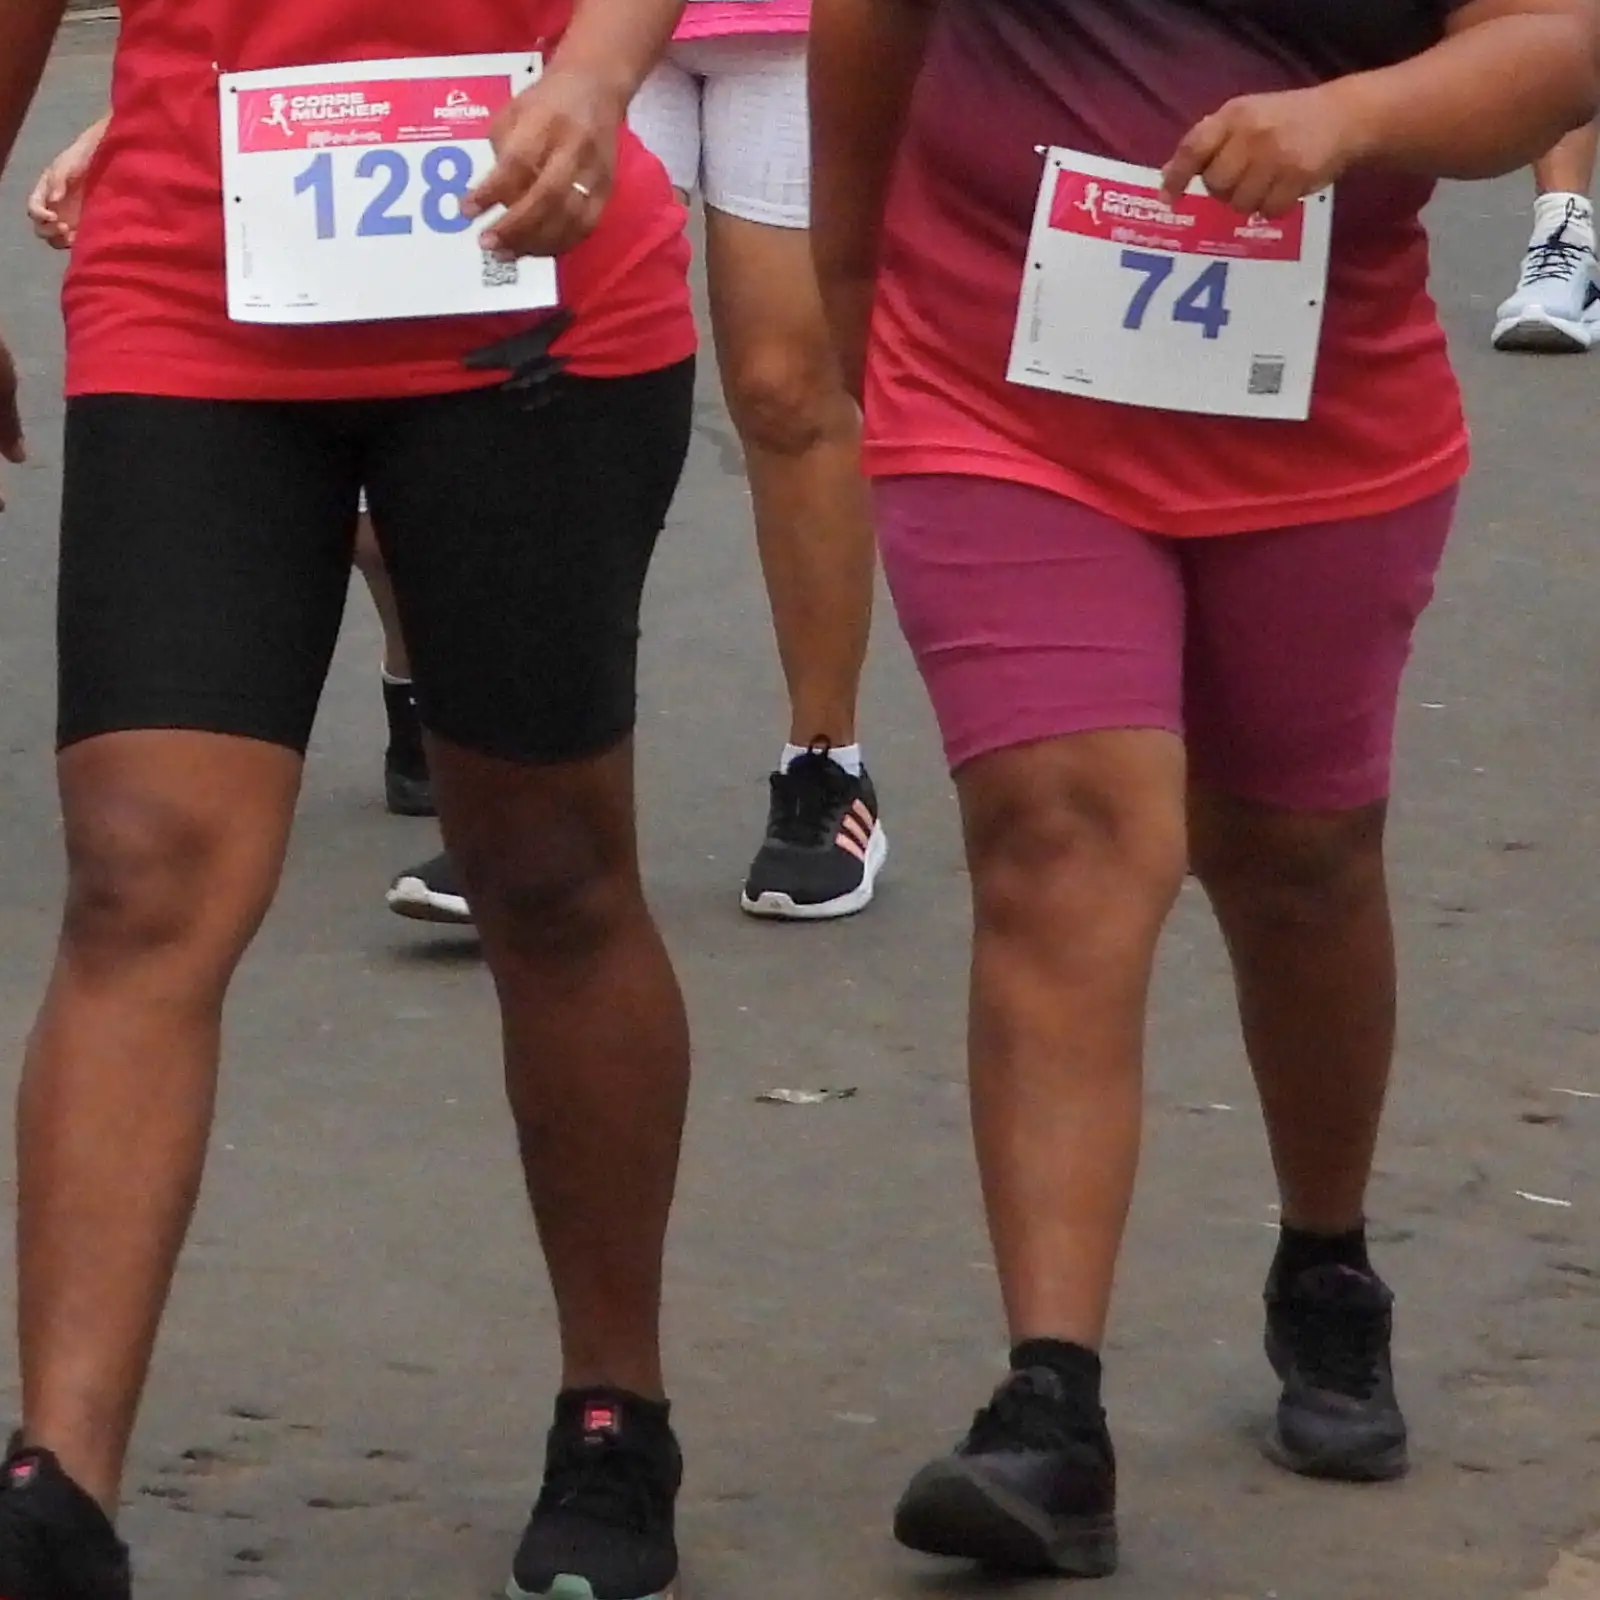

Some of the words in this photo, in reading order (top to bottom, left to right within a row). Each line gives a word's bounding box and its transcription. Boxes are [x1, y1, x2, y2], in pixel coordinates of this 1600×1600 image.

[290, 101, 391, 122] MULHER!
[291, 92, 365, 109] CORRE
[294, 146, 475, 240] 128
[1120, 249, 1231, 339] 74
